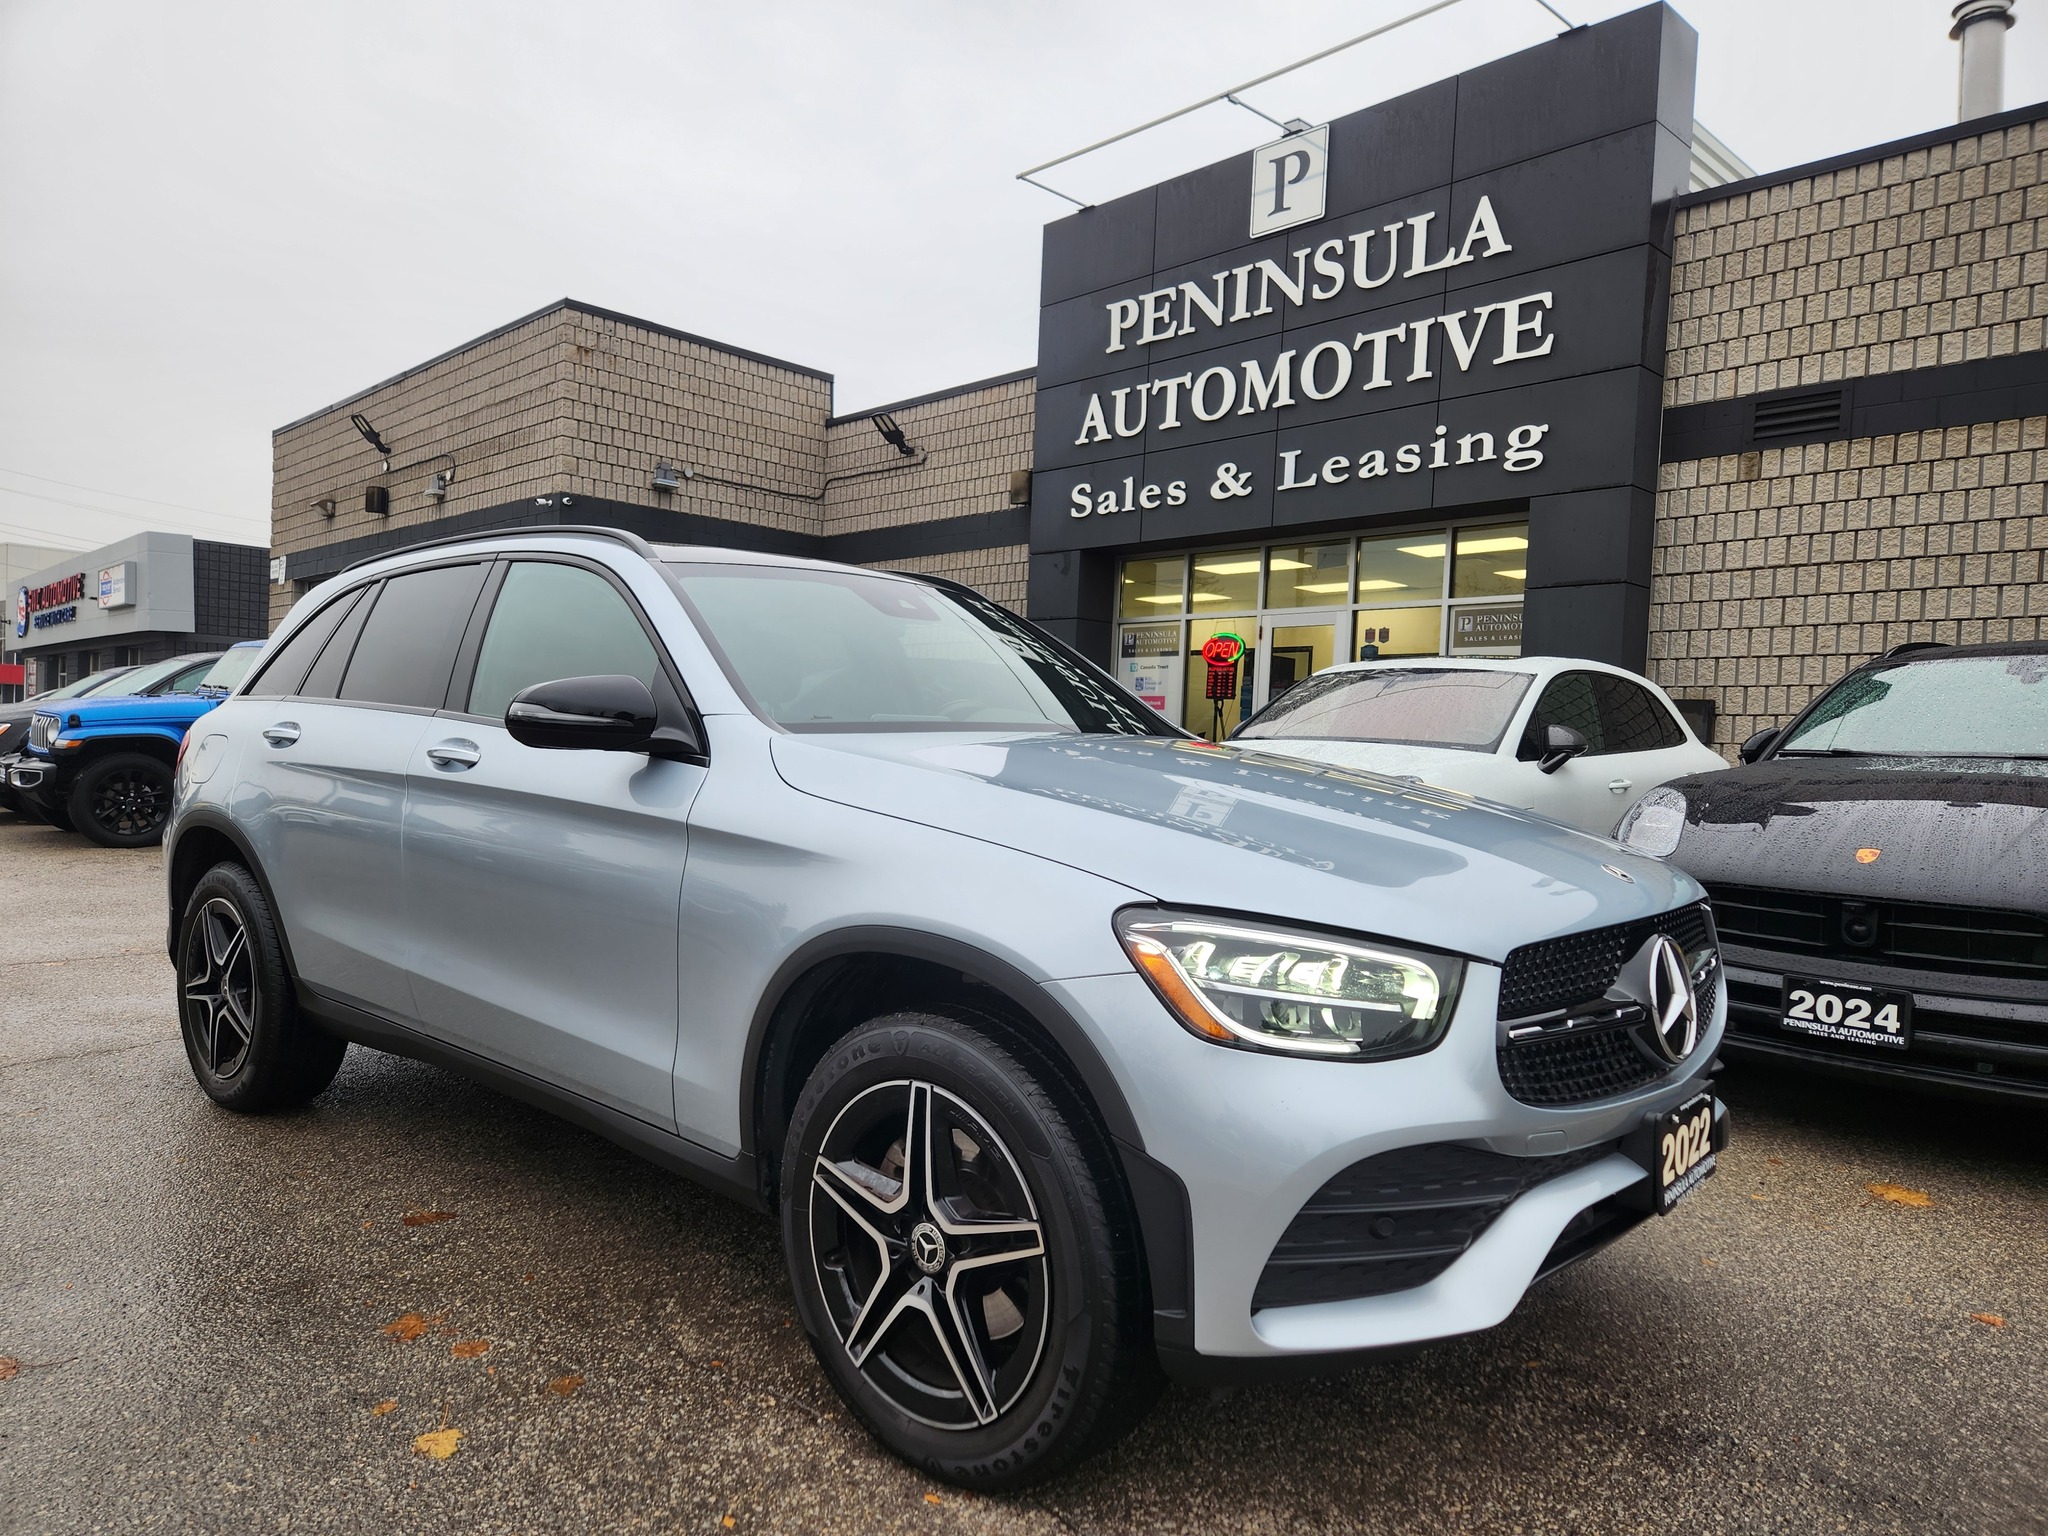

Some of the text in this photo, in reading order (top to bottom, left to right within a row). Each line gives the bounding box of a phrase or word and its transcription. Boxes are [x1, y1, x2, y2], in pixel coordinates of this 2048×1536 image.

[1266, 149, 1312, 218] P
[1105, 194, 1512, 354] PENINSULA
[1074, 290, 1555, 446] AUTOMOTIVE
[1070, 422, 1550, 519] Sales & Leasing
[42, 572, 82, 608] AUTOMOTIVE
[1136, 630, 1177, 639] PENINSULA
[1475, 623, 1523, 632] AUTOMOT
[1476, 613, 1523, 624] PENINSU
[1136, 637, 1177, 645] AUTOMOTIVE
[1205, 641, 1240, 658] OPEN
[1788, 989, 1901, 1034] 2024
[1783, 1017, 1905, 1045] PENINSULA AUTOMOTIVE
[1808, 1029, 1877, 1046] SALES AND LEASING
[1662, 1106, 1711, 1187] 2022
[953, 1364, 1081, 1480] Firestone
